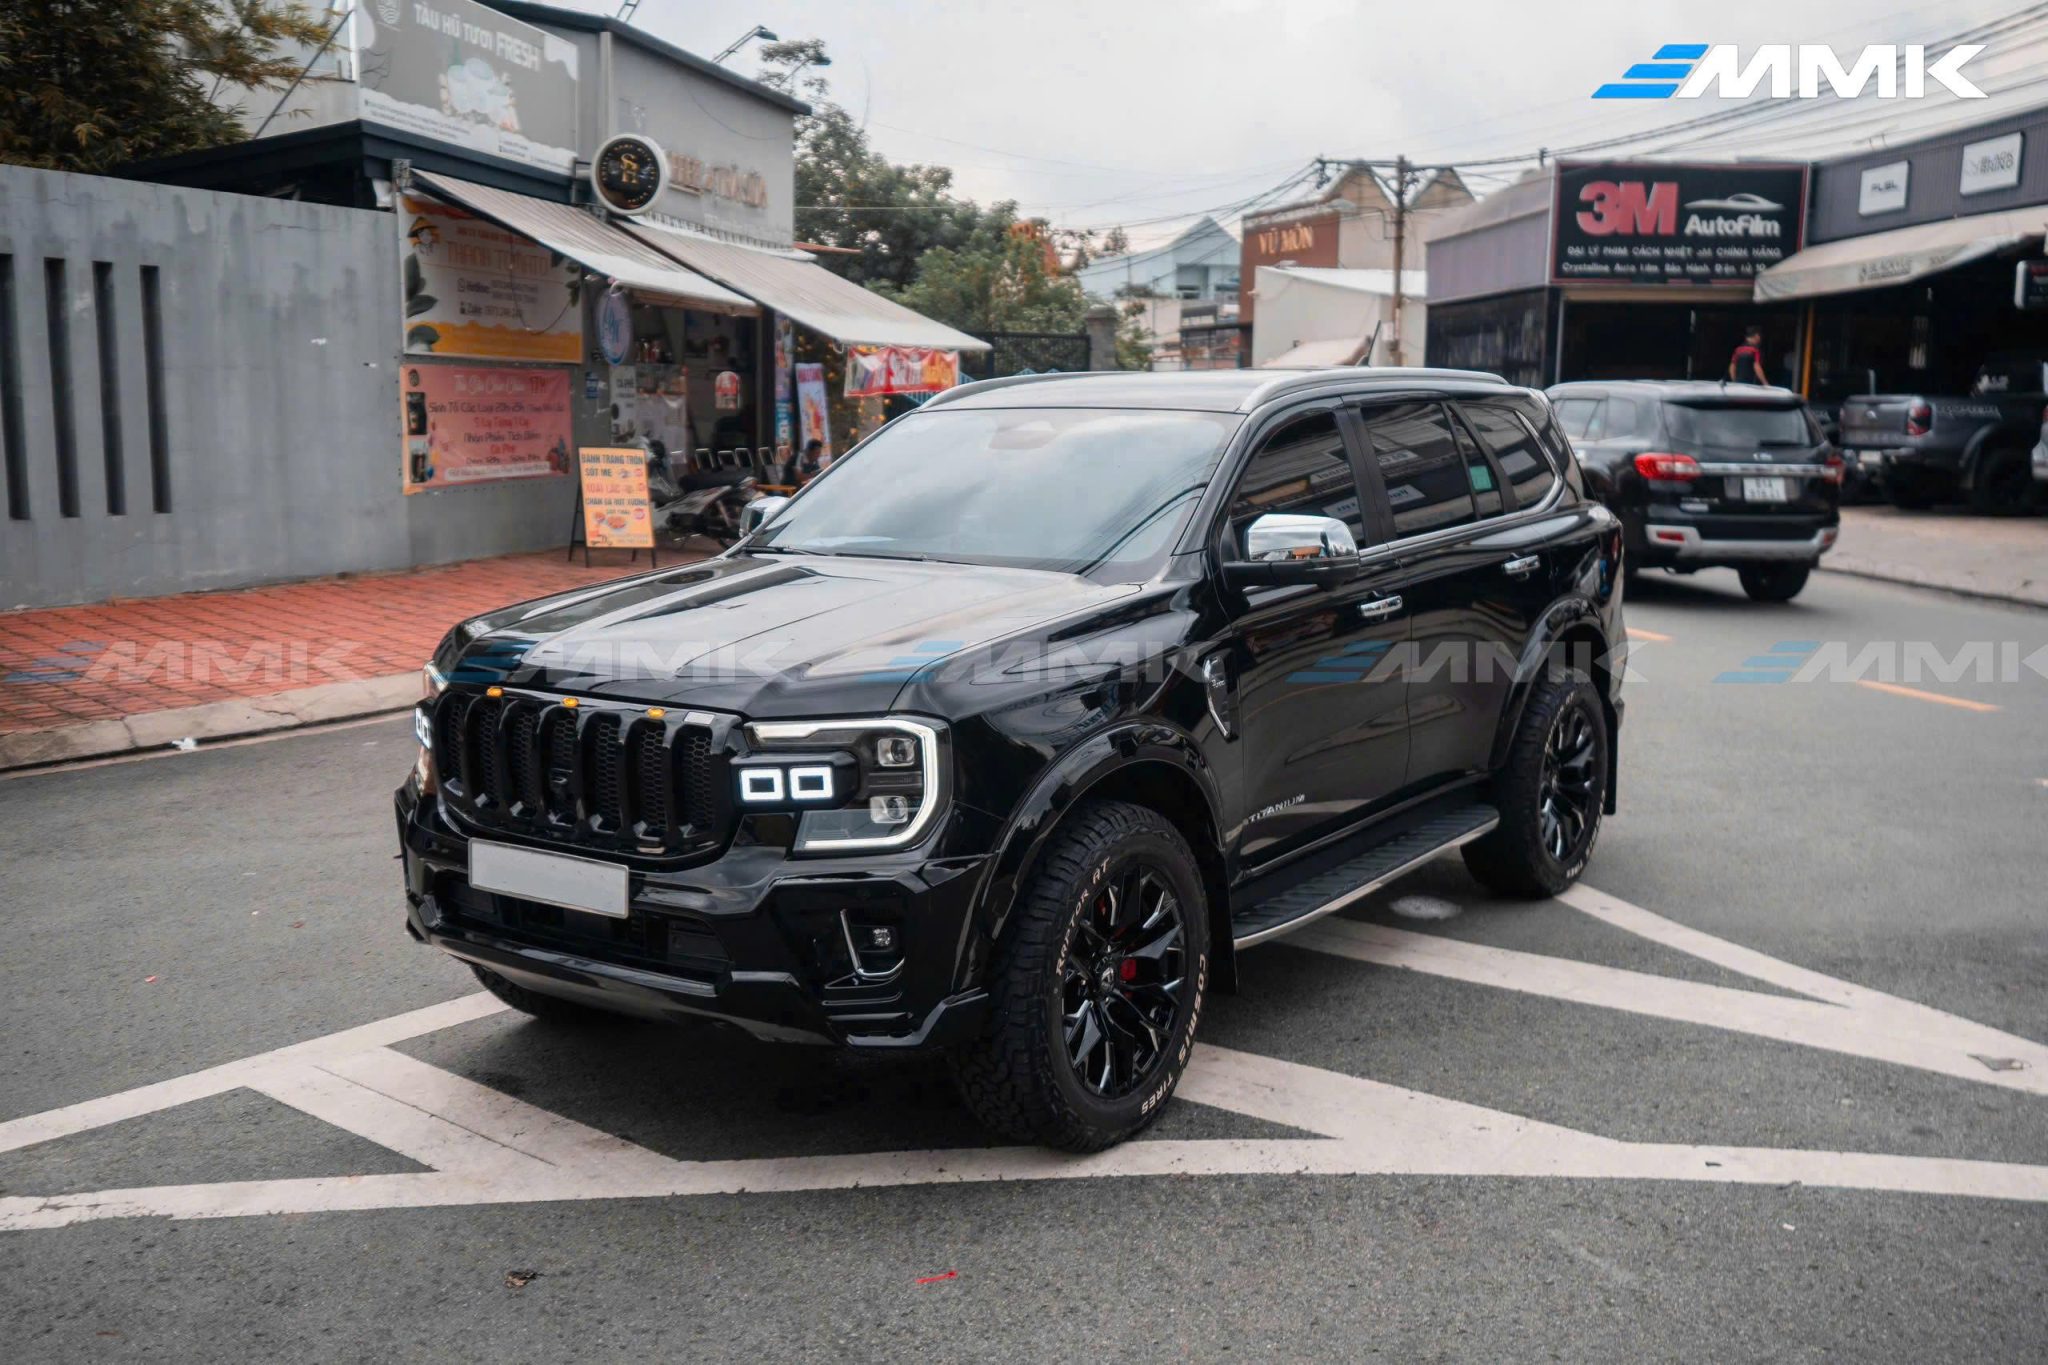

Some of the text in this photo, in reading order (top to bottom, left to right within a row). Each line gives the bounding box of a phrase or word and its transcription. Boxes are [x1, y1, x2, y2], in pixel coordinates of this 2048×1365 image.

[495, 32, 541, 72] FRESH
[1575, 181, 1679, 236] 3M
[1684, 214, 1781, 237] AutoFilm
[1603, 245, 1628, 257] PHIM
[1249, 793, 1306, 822] TITANIUM
[1055, 889, 1089, 976] RAPTOR
[1141, 953, 1209, 1116] COSMIS TIRES
